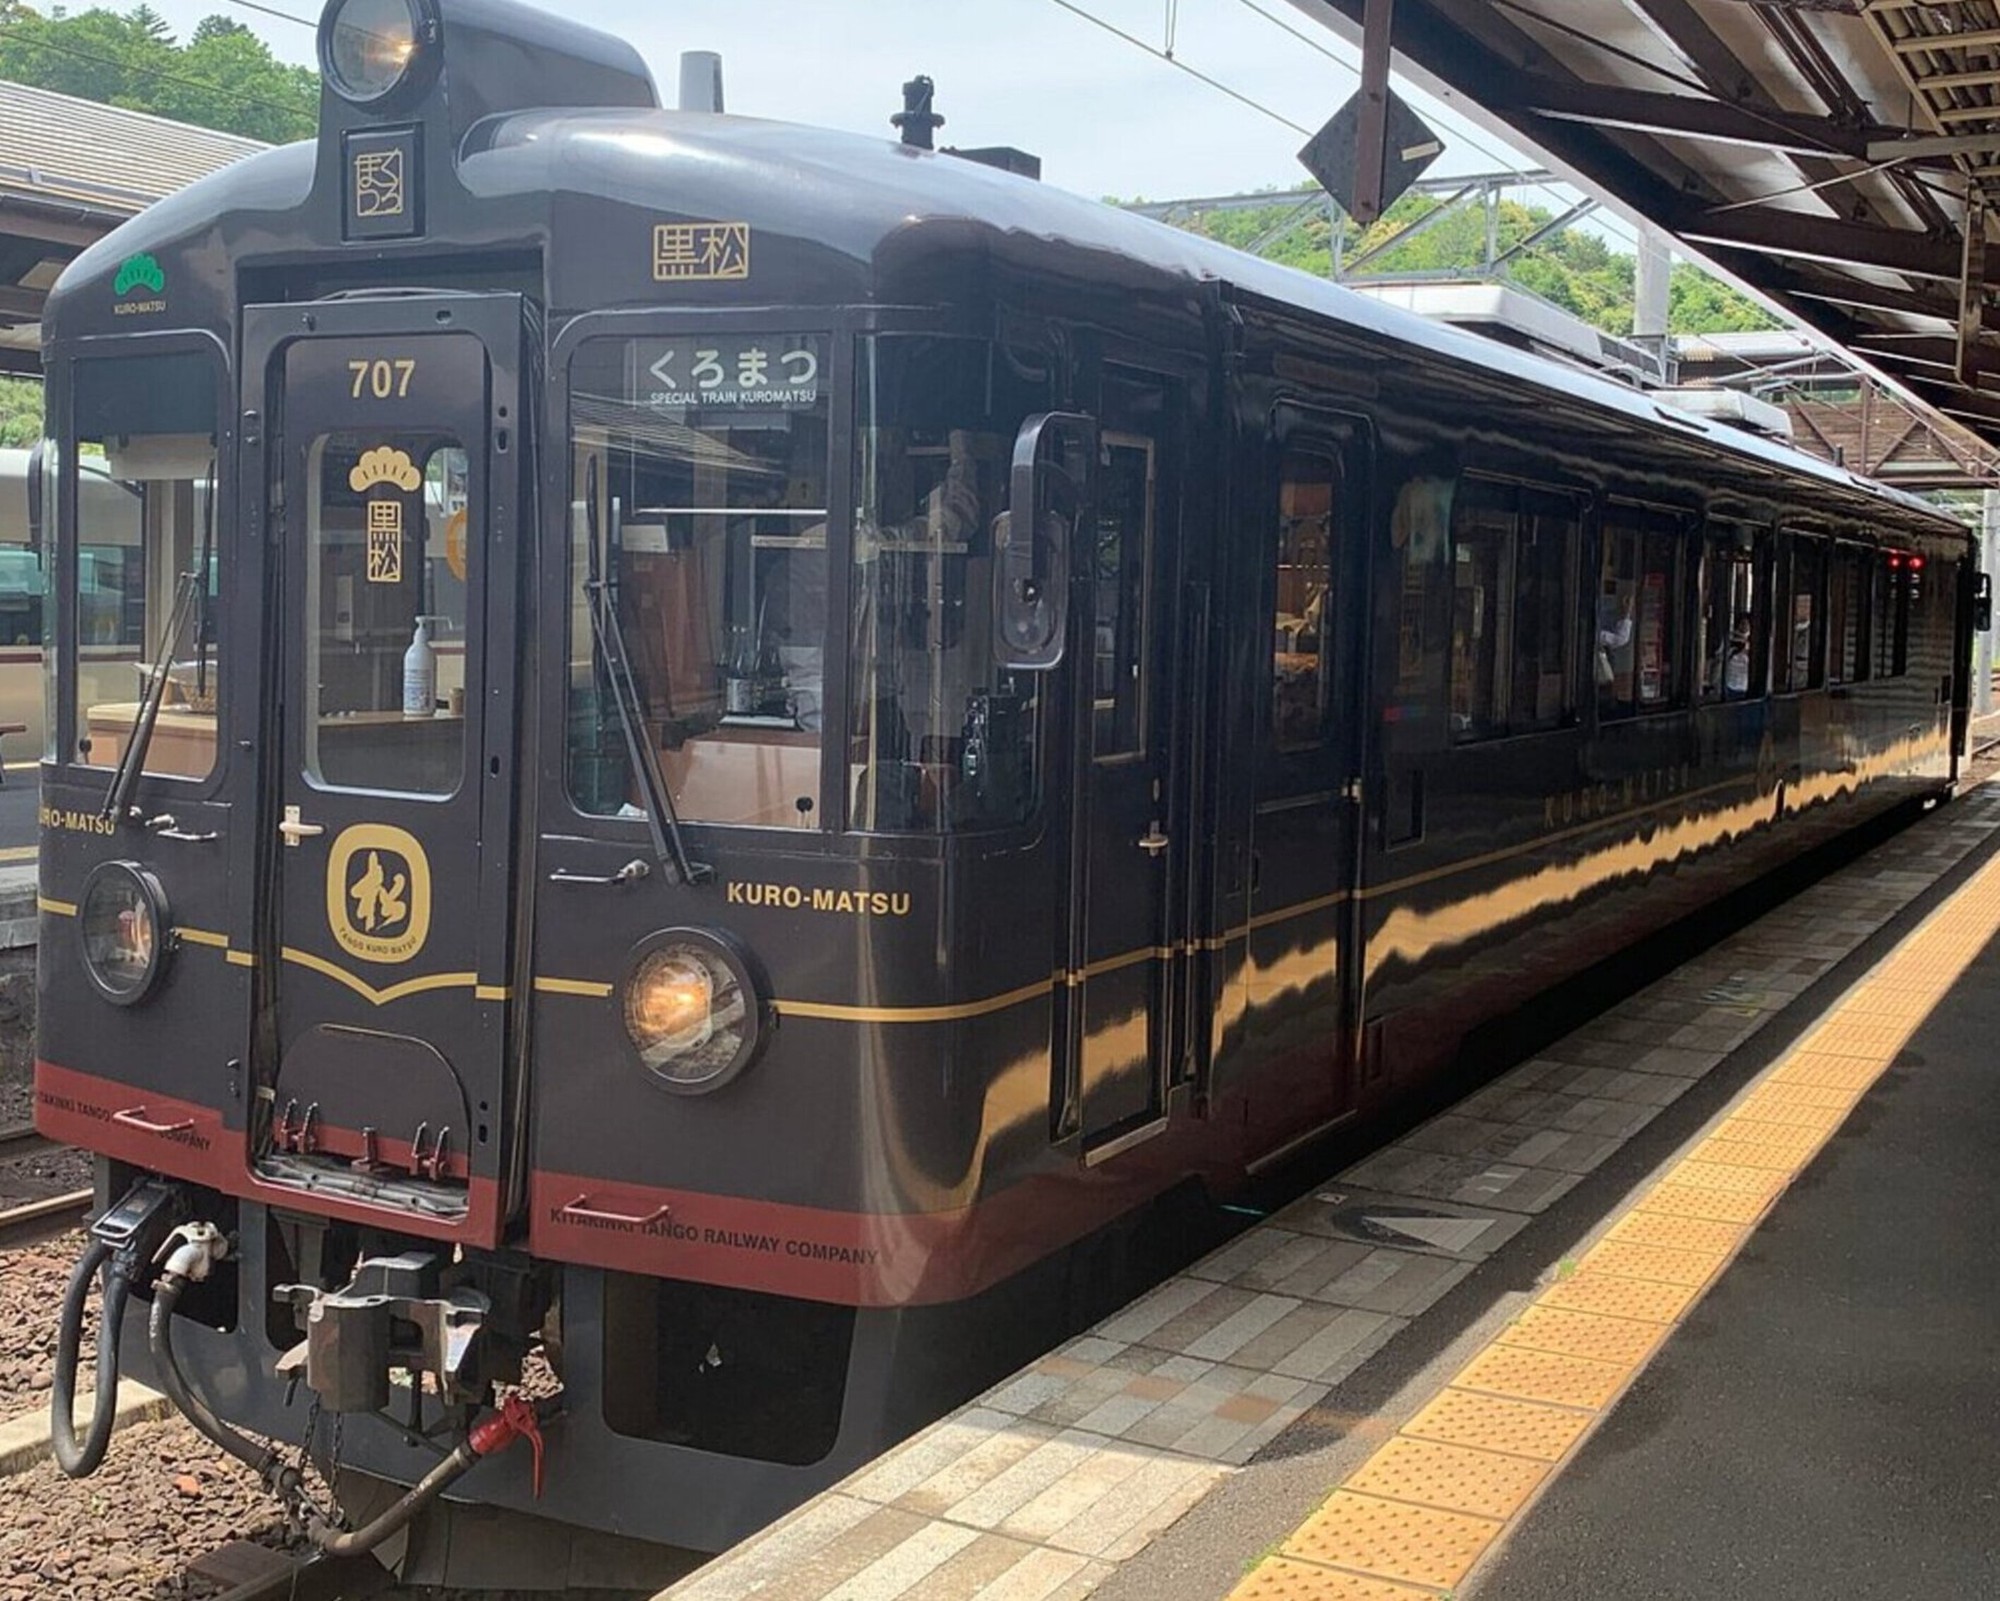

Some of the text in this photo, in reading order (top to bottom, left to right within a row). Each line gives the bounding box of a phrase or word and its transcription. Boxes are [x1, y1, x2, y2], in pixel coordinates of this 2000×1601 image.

[655, 223, 749, 279] 黒松
[114, 300, 166, 314] KURO-MATSU
[349, 360, 415, 398] 707
[650, 347, 817, 389] くろまつ
[651, 389, 816, 405] SPECIAL TRAIN KUROMATSU
[368, 501, 402, 582] 黒松
[727, 882, 910, 915] KURO-MATSU
[77, 1102, 110, 1123] TANGO
[641, 1214, 699, 1241] TANGO
[704, 1228, 780, 1253] RAILWAY
[785, 1240, 878, 1264] COMPANY
